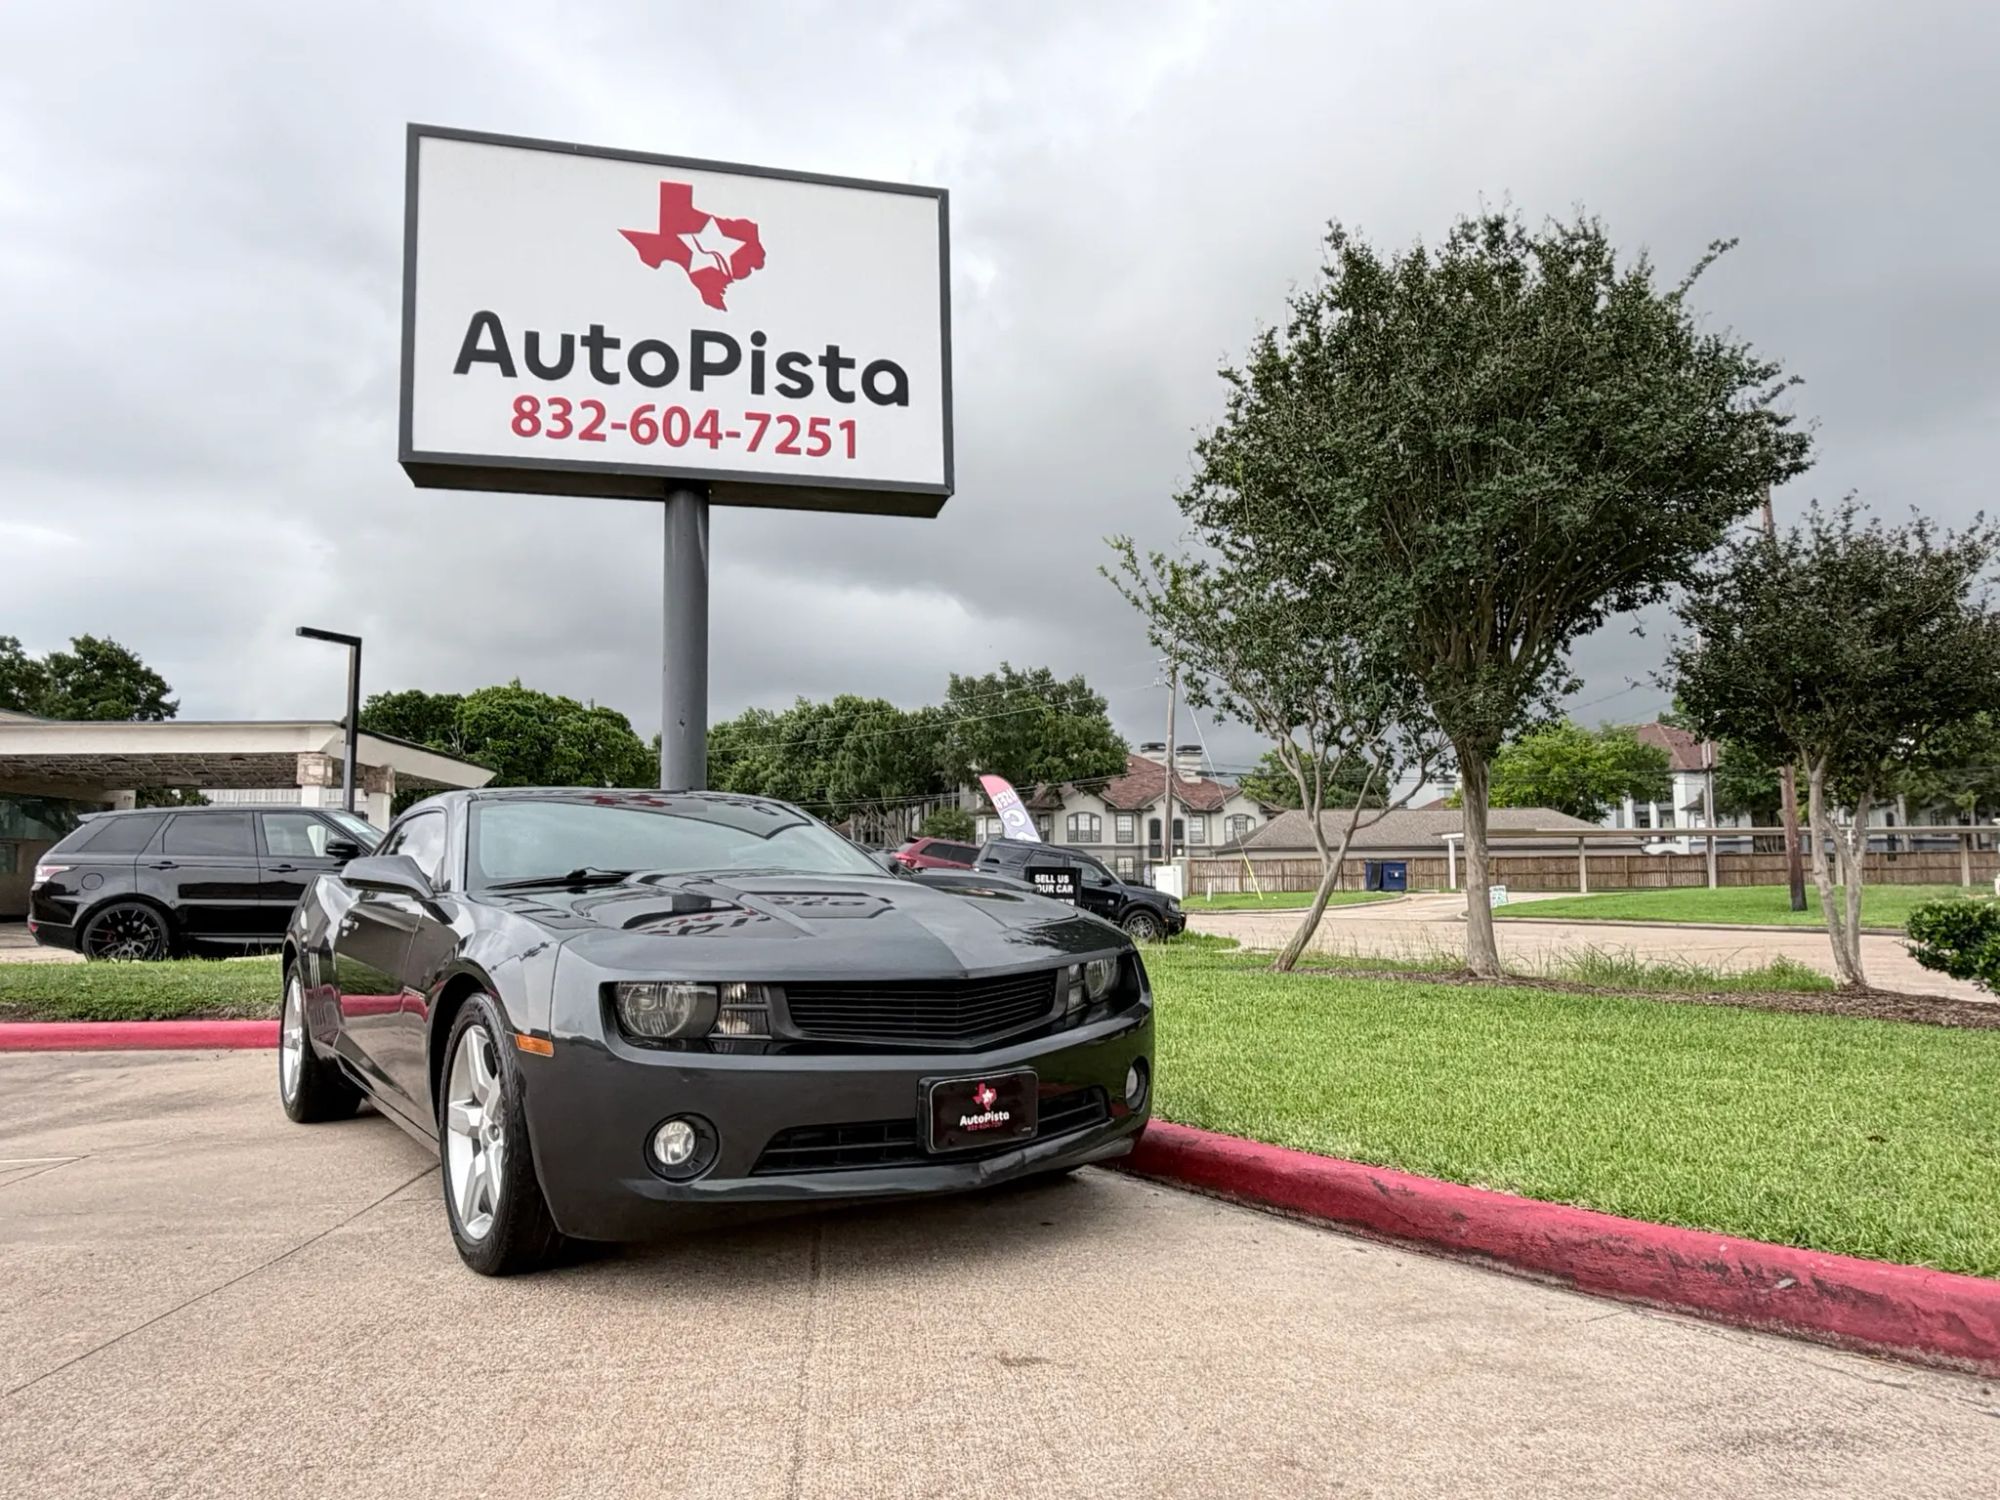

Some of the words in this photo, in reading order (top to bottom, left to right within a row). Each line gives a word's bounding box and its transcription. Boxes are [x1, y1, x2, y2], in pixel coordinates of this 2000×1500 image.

[453, 309, 910, 408] AutoPista
[510, 394, 857, 460] 832-604-7251
[1034, 874, 1056, 884] SELL
[1057, 874, 1070, 884] US
[1056, 884, 1074, 894] CAR
[960, 1110, 1010, 1127] AutoPista
